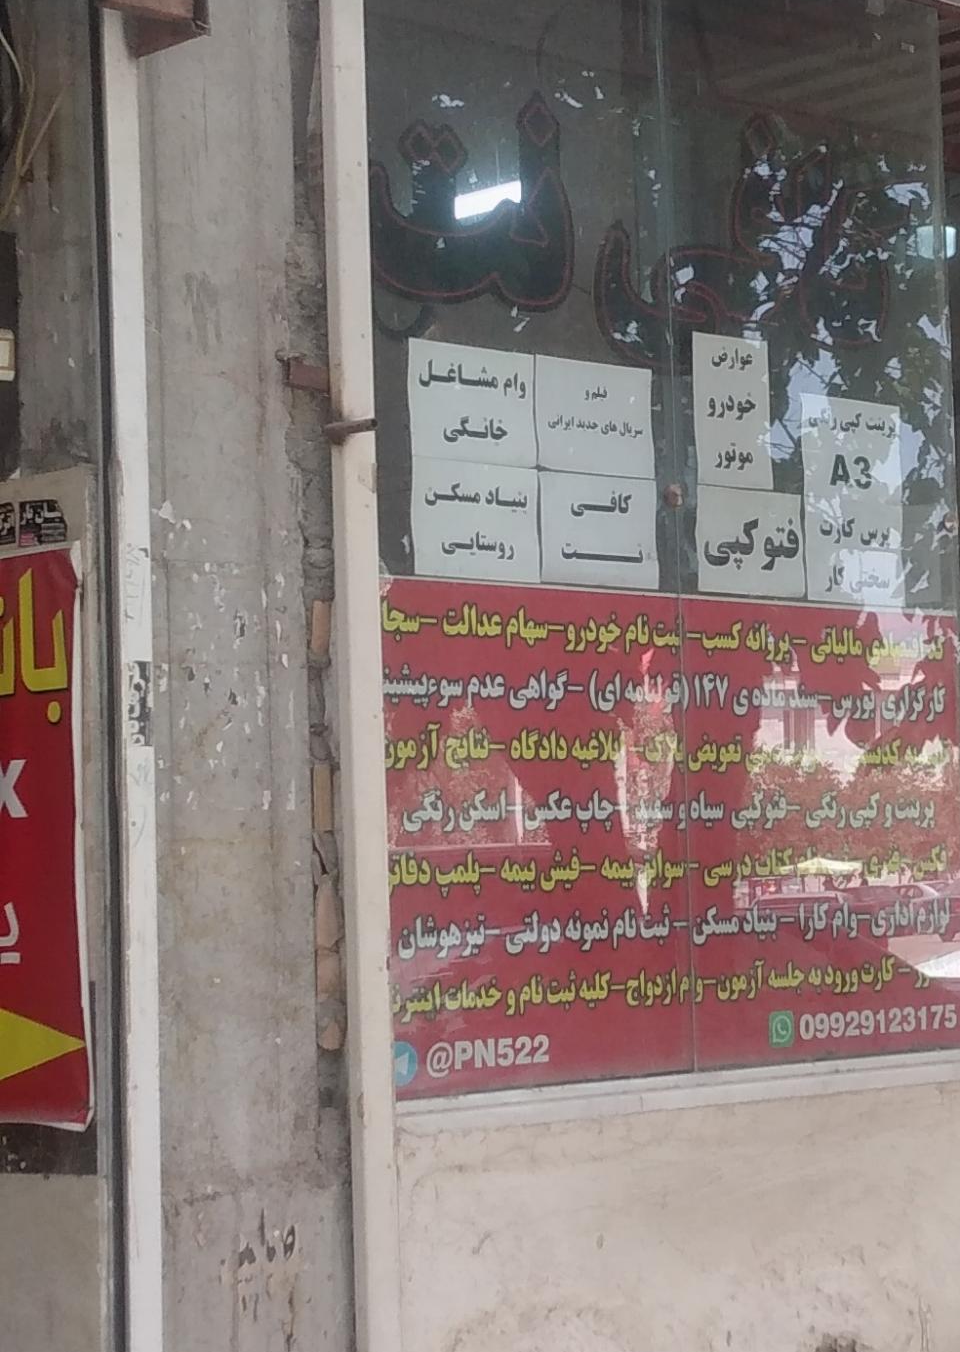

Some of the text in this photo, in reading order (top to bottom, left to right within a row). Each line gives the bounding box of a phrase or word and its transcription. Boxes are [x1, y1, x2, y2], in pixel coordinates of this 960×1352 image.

[711, 347, 753, 370] عوارض
[418, 358, 527, 399] وام مشاغل
[547, 414, 575, 431] ایرانی
[706, 395, 757, 419] خودرو
[839, 413, 863, 434] کپی
[443, 415, 508, 443] خانگی
[600, 420, 618, 436] های
[619, 419, 644, 439] سریال
[865, 416, 898, 439] پرینت
[714, 443, 754, 471] موتور
[829, 453, 873, 490] A3
[424, 483, 528, 514] بنیاد مسکن
[570, 491, 633, 517] کافی
[441, 531, 515, 560] روستایی
[819, 518, 856, 544] کارت
[561, 542, 644, 564] نت
[825, 564, 845, 593] کار
[442, 600, 503, 638] عدالت
[505, 605, 549, 648] سهام
[564, 613, 622, 653] خودرو
[625, 613, 650, 654] نام
[652, 615, 684, 657] ثبت
[700, 621, 743, 658] کسب
[746, 621, 791, 663] پروانه
[811, 626, 863, 665] مالیاتی
[467, 673, 505, 708] عدم
[509, 668, 569, 711] گواهی
[693, 672, 729, 709] ۱۴۷
[832, 691, 876, 721] بورس
[385, 722, 441, 770] آزمون
[445, 725, 490, 769] نتایج
[510, 726, 568, 761] دادگاه
[571, 726, 626, 769] ابلاغیه
[688, 734, 742, 773] تعویض
[402, 788, 455, 832] رنگی
[459, 789, 507, 832] اسکن
[523, 790, 573, 831] عکس
[576, 789, 615, 833] چاپ
[634, 797, 673, 827] سفید
[678, 802, 687, 830] و
[690, 790, 725, 829] سیاه
[806, 792, 846, 829] رنگی
[850, 792, 881, 830] کپی
[883, 802, 893, 828] و
[896, 794, 935, 829] پرینت
[435, 850, 482, 898] پلمپ
[500, 857, 537, 891] بیمه
[540, 847, 581, 892] فیش
[600, 855, 635, 889] بیمه
[639, 847, 686, 890] سوابق
[703, 853, 752, 887] درسی
[505, 910, 561, 956] دولتی
[564, 907, 609, 953] نمونه
[611, 906, 637, 949] نام
[640, 902, 671, 946] ثبت
[691, 905, 741, 946] مسکن
[742, 901, 778, 941] بنیاد
[800, 901, 829, 941] کارا
[832, 901, 859, 938] وام
[870, 897, 914, 938] اداری
[915, 897, 951, 936] لوازم
[546, 970, 577, 1011] ثبت
[578, 970, 612, 1009] کلیه
[626, 968, 678, 1009] ازدواج
[714, 959, 765, 1001] آزمون
[766, 961, 806, 995] جلسه
[807, 968, 822, 994] به
[823, 964, 860, 997] ورود
[861, 954, 896, 993] کارت
[444, 977, 503, 1013] خدمات
[505, 989, 517, 1017] و
[518, 973, 544, 1016] نام
[799, 1003, 958, 1041] 09929123175
[425, 1034, 550, 1078] @PN522
